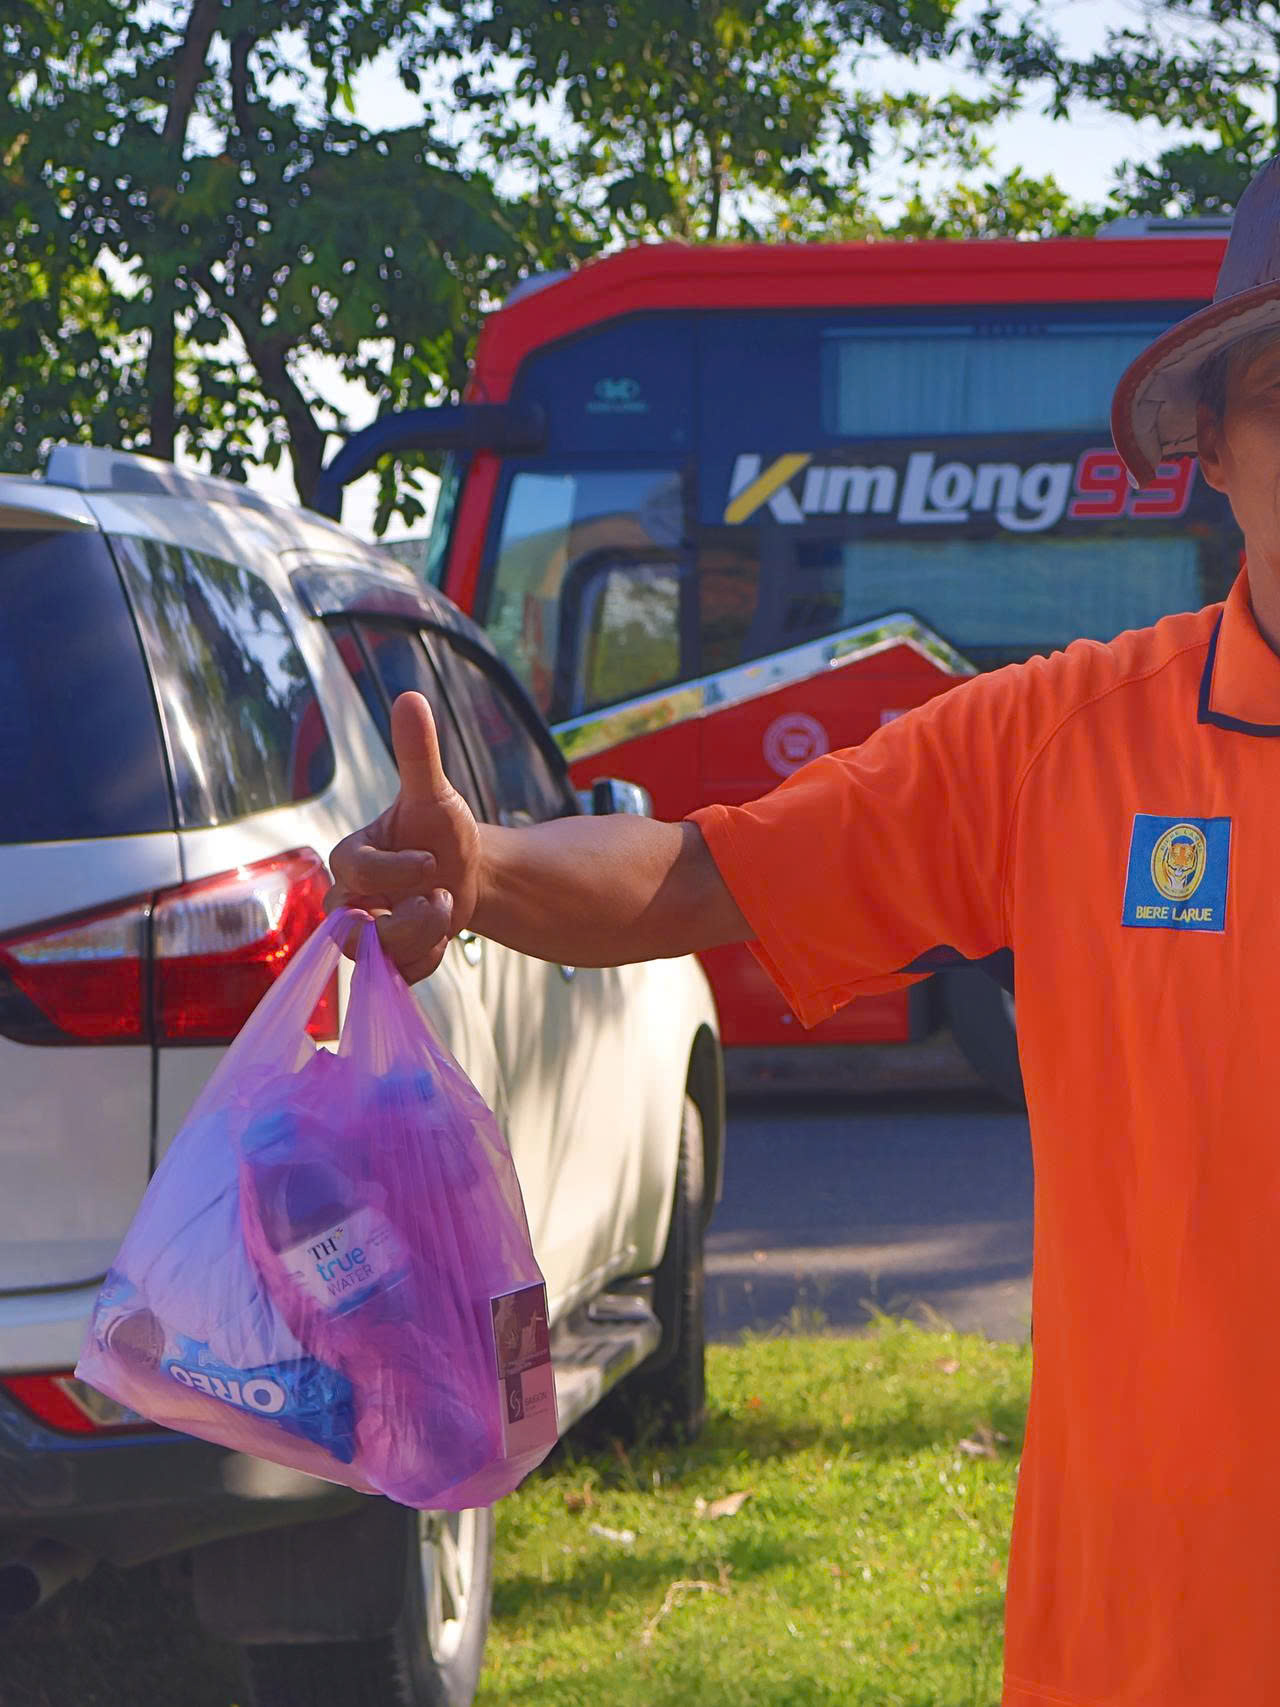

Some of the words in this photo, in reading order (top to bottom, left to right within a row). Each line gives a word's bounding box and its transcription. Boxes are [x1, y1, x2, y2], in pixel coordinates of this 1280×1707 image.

[1136, 906, 1169, 919] BIERE
[1172, 908, 1213, 922] LARUE
[307, 1238, 338, 1260] TH
[316, 1248, 367, 1282] true
[327, 1264, 375, 1296] WATER
[168, 1364, 285, 1414] OREO
